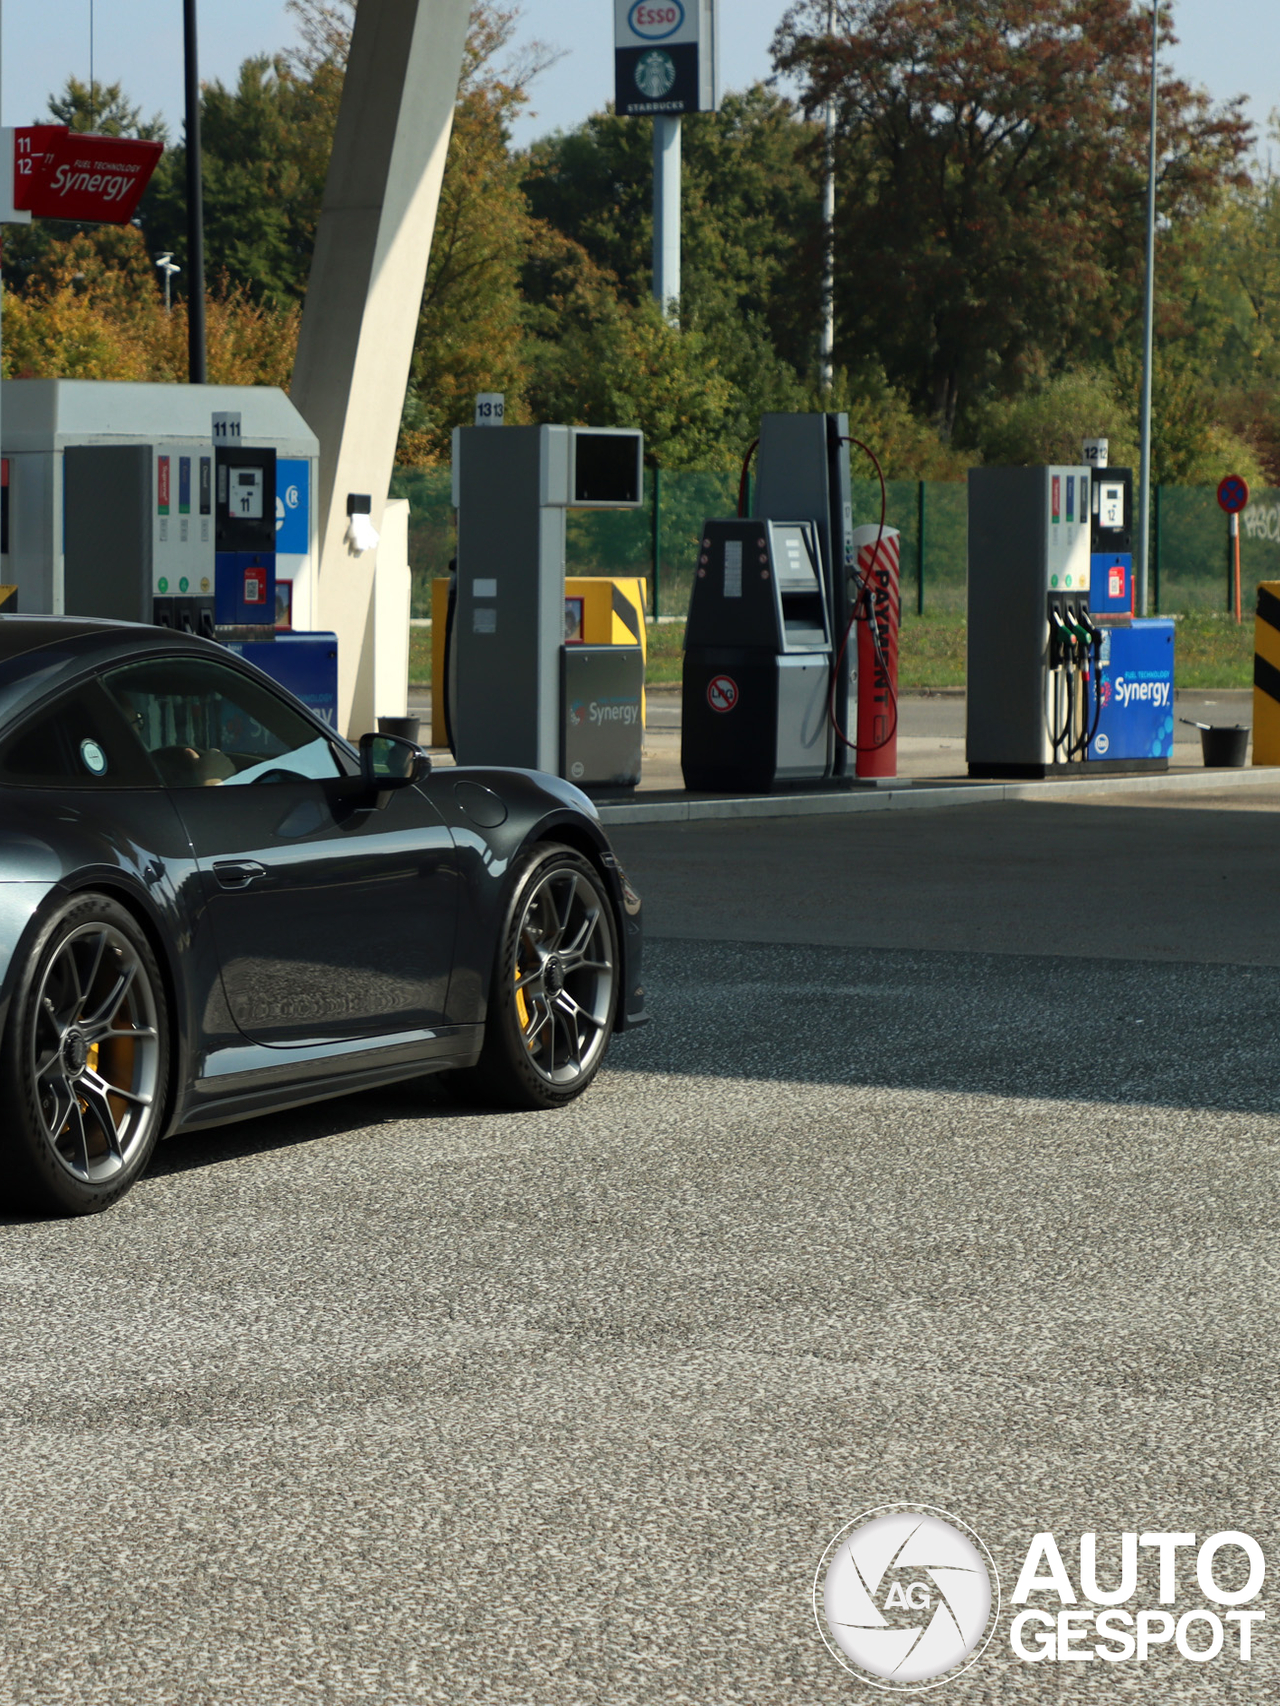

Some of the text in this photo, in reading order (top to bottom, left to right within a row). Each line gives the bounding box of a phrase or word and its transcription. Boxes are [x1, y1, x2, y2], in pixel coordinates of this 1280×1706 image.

[636, 5, 676, 25] Esso
[626, 101, 684, 113] STARBUCKS
[18, 137, 31, 153] 11
[18, 158, 32, 174] 12
[73, 159, 141, 173] FUEL TECHNOLOGY
[50, 164, 136, 201] Synergy
[477, 402, 503, 418] 13 13
[213, 421, 241, 437] 11 11
[1084, 446, 1098, 459] 12
[240, 497, 250, 513] 11
[1108, 509, 1116, 522] 12
[873, 569, 890, 708] PAYMENT
[1114, 676, 1170, 707] Synergy
[589, 702, 639, 725] Synergy
